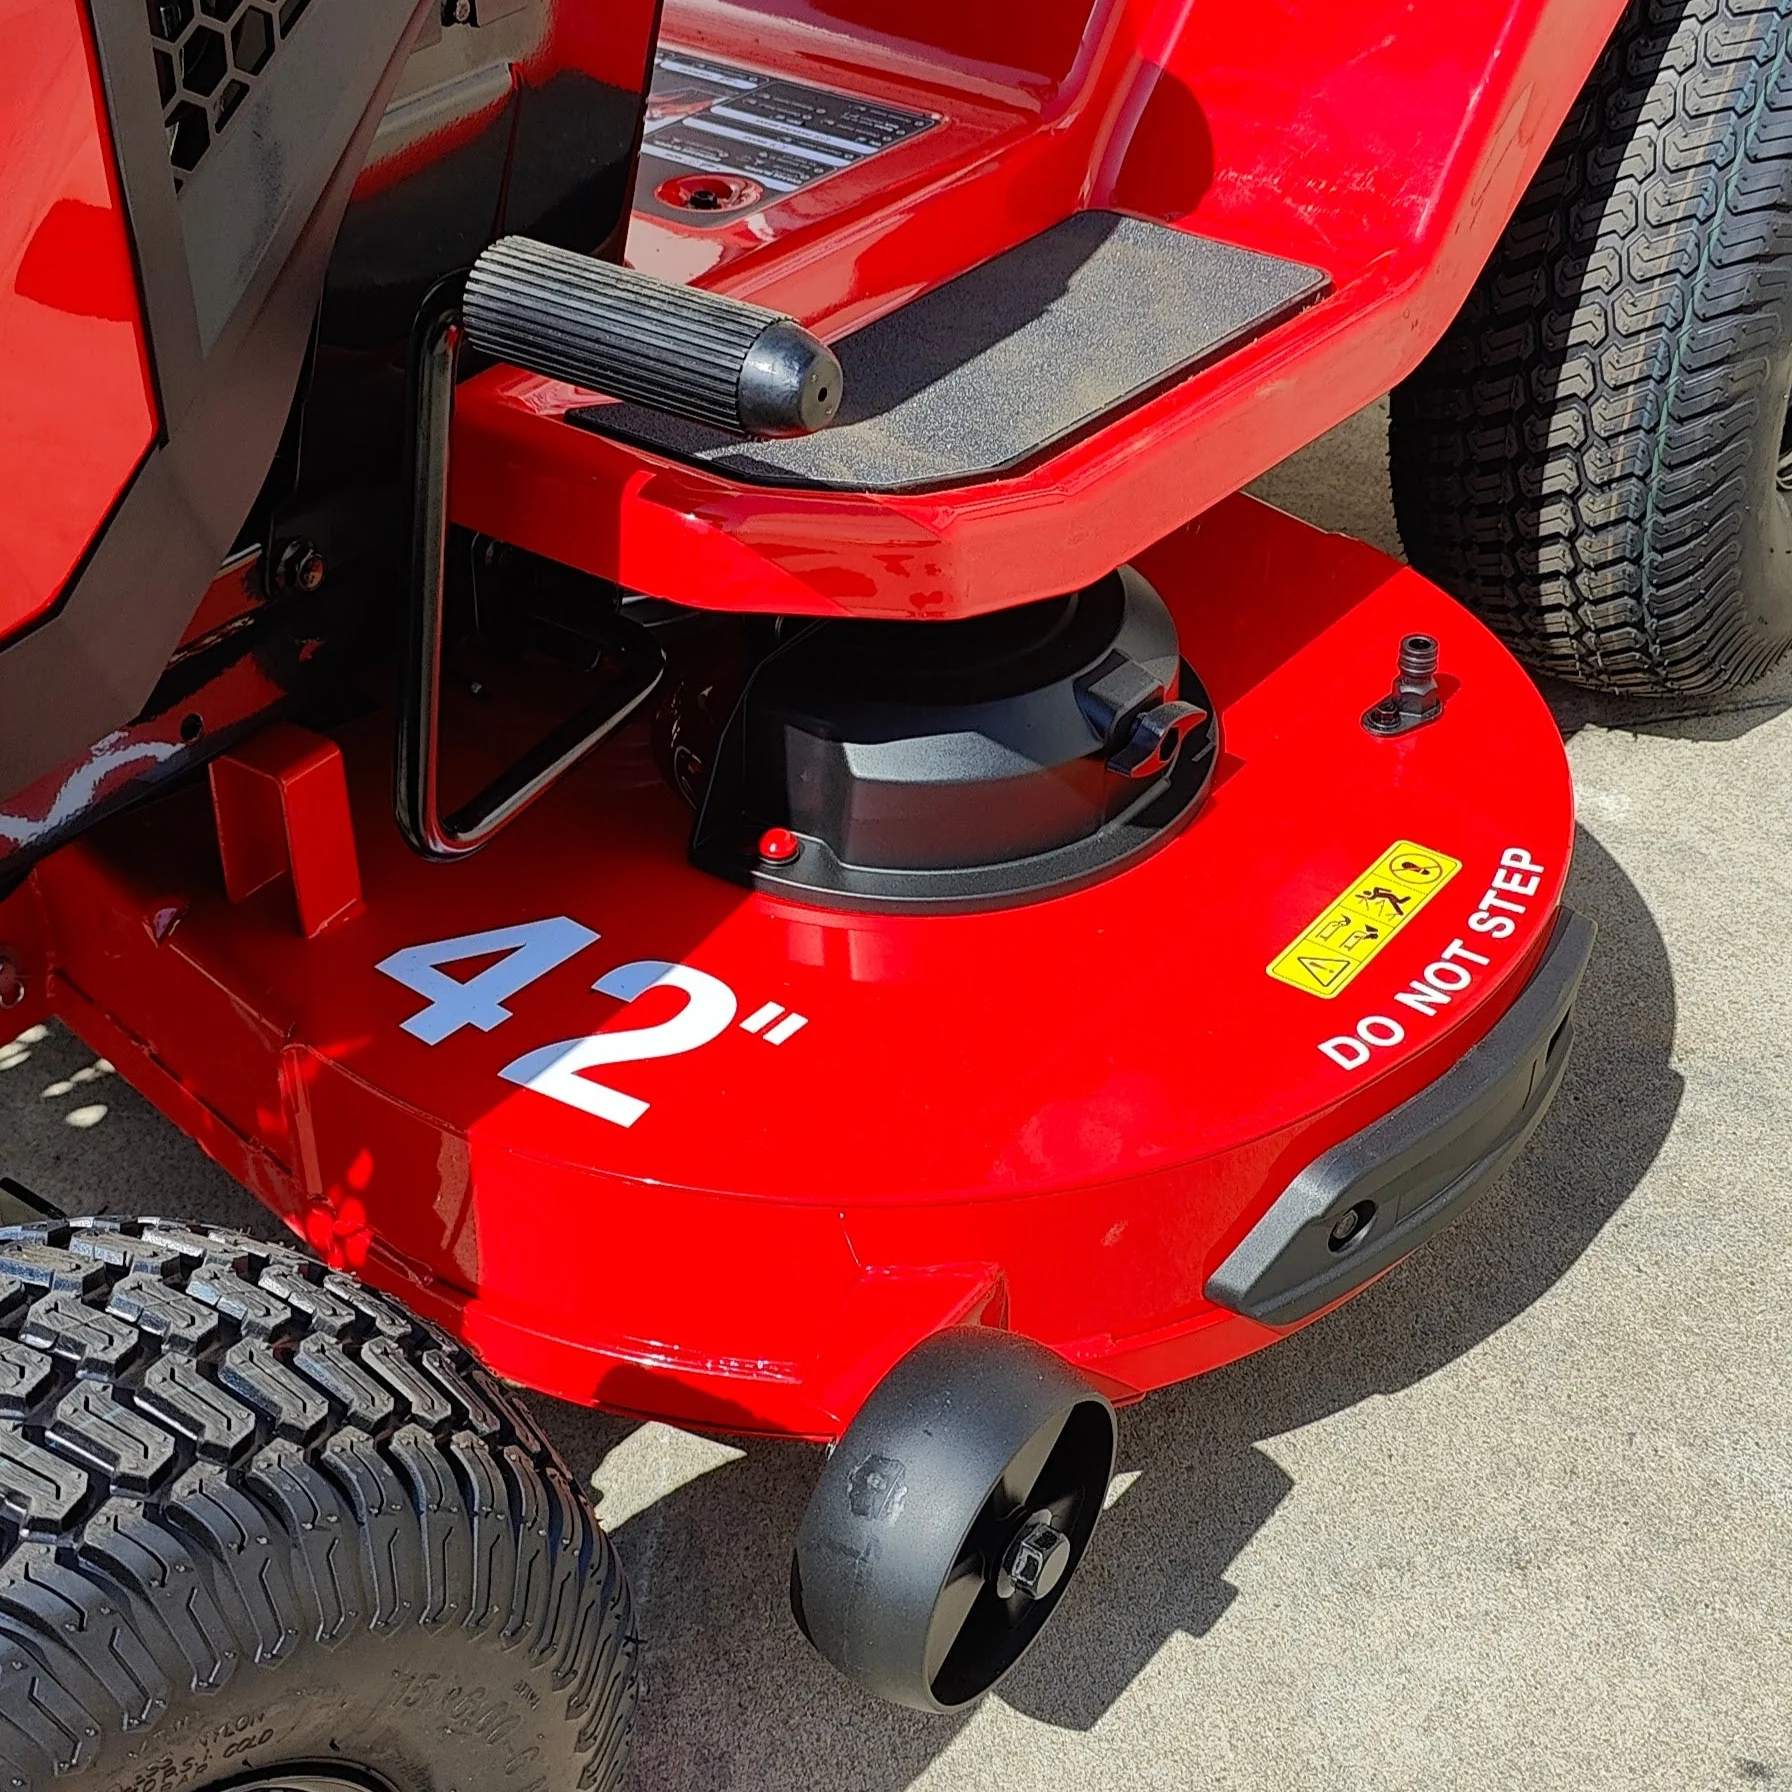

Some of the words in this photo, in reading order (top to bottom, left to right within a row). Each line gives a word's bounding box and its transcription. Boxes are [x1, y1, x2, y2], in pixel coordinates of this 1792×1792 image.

[374, 915, 809, 1129] 42"
[1317, 1015, 1405, 1071] DO
[1394, 939, 1490, 1017] NOT
[1467, 847, 1545, 940] STEP
[221, 1728, 274, 1759] COLD
